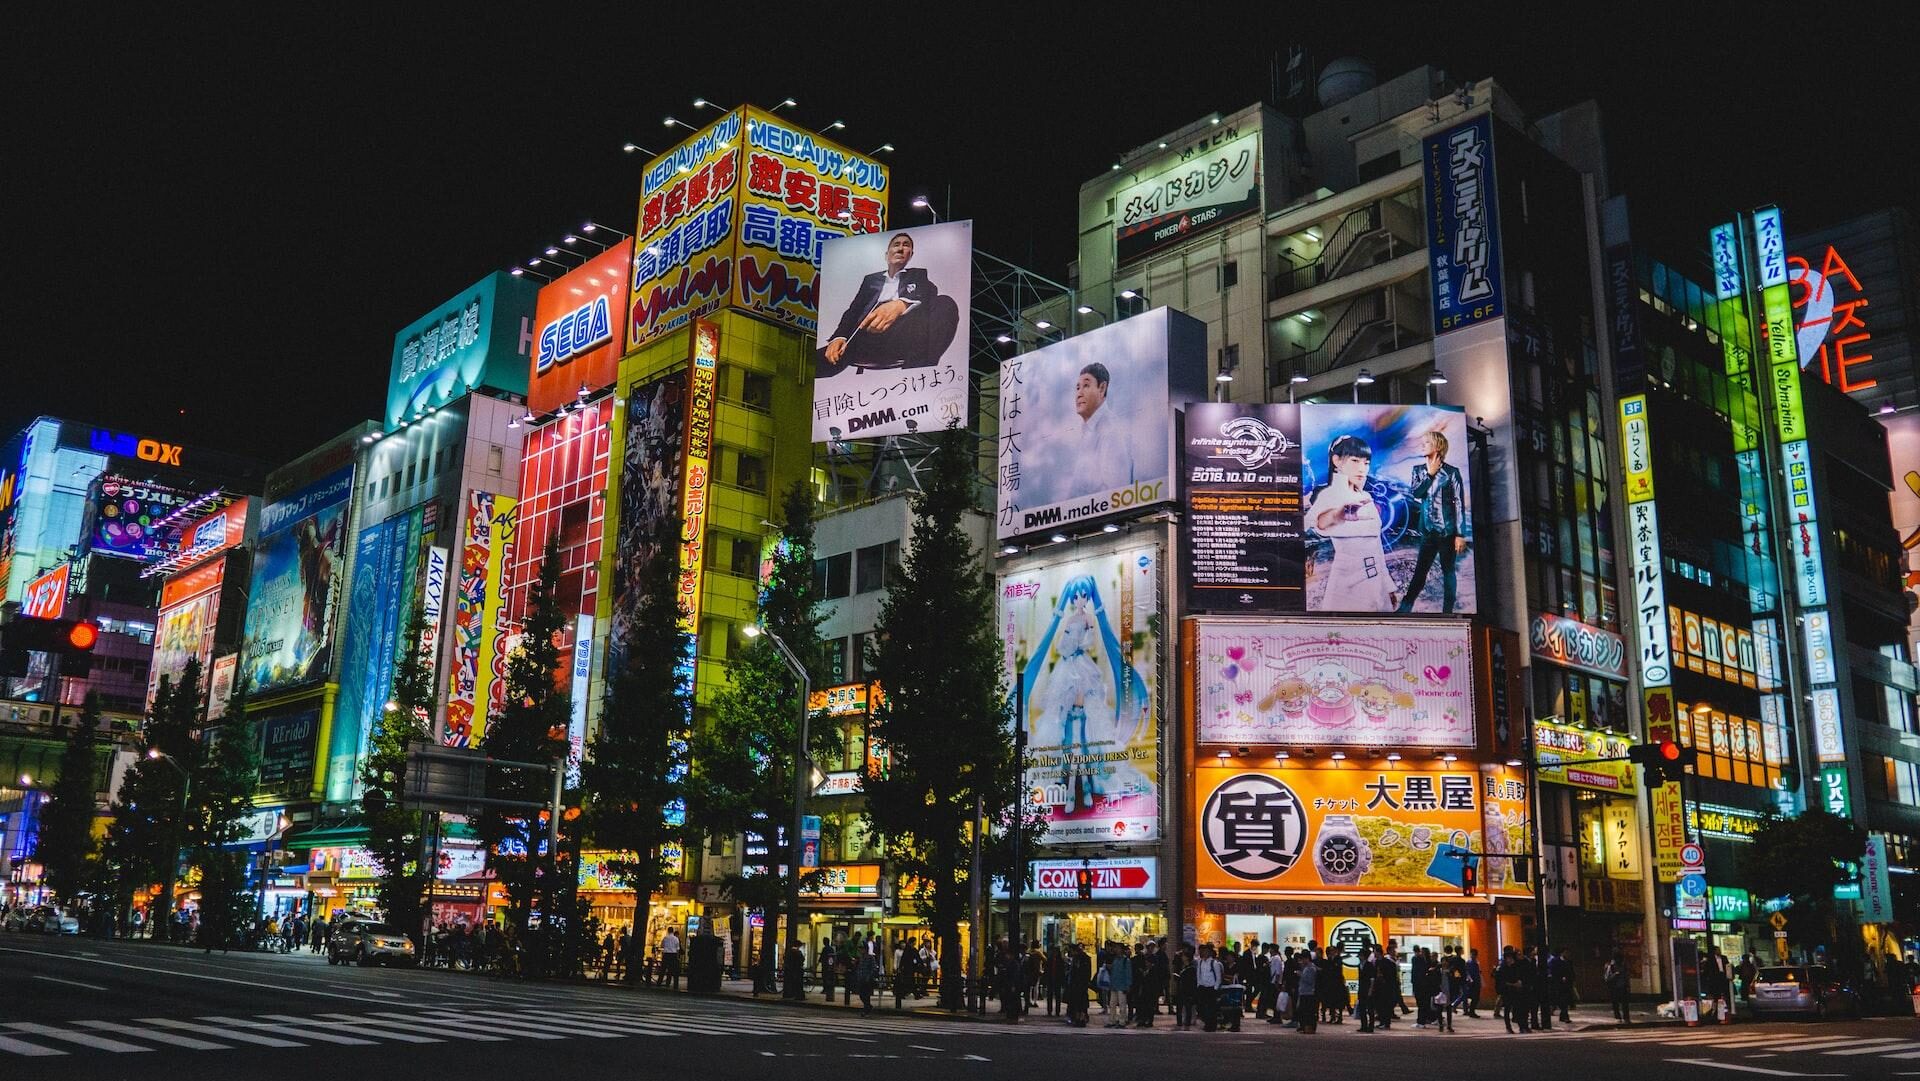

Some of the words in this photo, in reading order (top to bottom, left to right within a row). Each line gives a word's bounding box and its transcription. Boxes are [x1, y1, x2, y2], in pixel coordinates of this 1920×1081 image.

[644, 112, 739, 196] MEDIAリサイクル
[750, 119, 885, 191] MEDIAリサイクル
[640, 149, 738, 241] 激安販売
[748, 153, 883, 233] 激安販売
[1123, 150, 1250, 226] メイドカジノ
[1155, 223, 1179, 241] POKER
[1192, 208, 1217, 226] STARS
[635, 197, 732, 292] 高額買取
[1436, 255, 1450, 309] 秋葉原店
[632, 256, 732, 344] Mulan
[537, 295, 612, 374] SEGA
[667, 314, 688, 332] AKIBA
[797, 315, 818, 332] AKI
[1770, 319, 1786, 359] Yellow
[695, 368, 713, 380] DVD
[693, 389, 712, 401] ゲーム
[696, 398, 708, 408] CD
[813, 366, 964, 421] 冒険しつづけよう。
[1626, 402, 1641, 414] 3F
[1777, 369, 1794, 435] Submarine
[691, 418, 710, 430] アニメ
[847, 403, 929, 433] DMM.com
[1000, 359, 1023, 536] 次は太陽か。
[1630, 421, 1644, 471] りらくる
[1788, 443, 1802, 452] 5F
[1192, 472, 1256, 482] 2018.10.10
[1275, 475, 1298, 483] sale
[1110, 480, 1164, 509] solar
[1004, 583, 1041, 600] 初音ミク
[576, 639, 591, 678] SEGA
[1531, 616, 1625, 671] メイドカジノ
[1445, 690, 1463, 698] cafe
[1063, 752, 1101, 765] WEDDING
[1104, 750, 1129, 761] DRESS
[1129, 747, 1149, 760] Ver.
[1314, 796, 1361, 811] チケット
[1365, 775, 1475, 812] 大黒屋
[1066, 826, 1082, 836] goods
[1083, 825, 1095, 834] and
[1095, 825, 1111, 834] more
[1214, 790, 1299, 868] 質
[1656, 791, 1671, 848] 세점
[1670, 802, 1683, 848] FREE
[1617, 819, 1630, 869] ルノアール
[1685, 850, 1699, 859] 40
[1038, 890, 1080, 898] Akihabar
[1040, 869, 1094, 889] COM
[1097, 869, 1121, 888] ZIN
[1687, 879, 1697, 894] P
[1871, 895, 1881, 915] cafe
